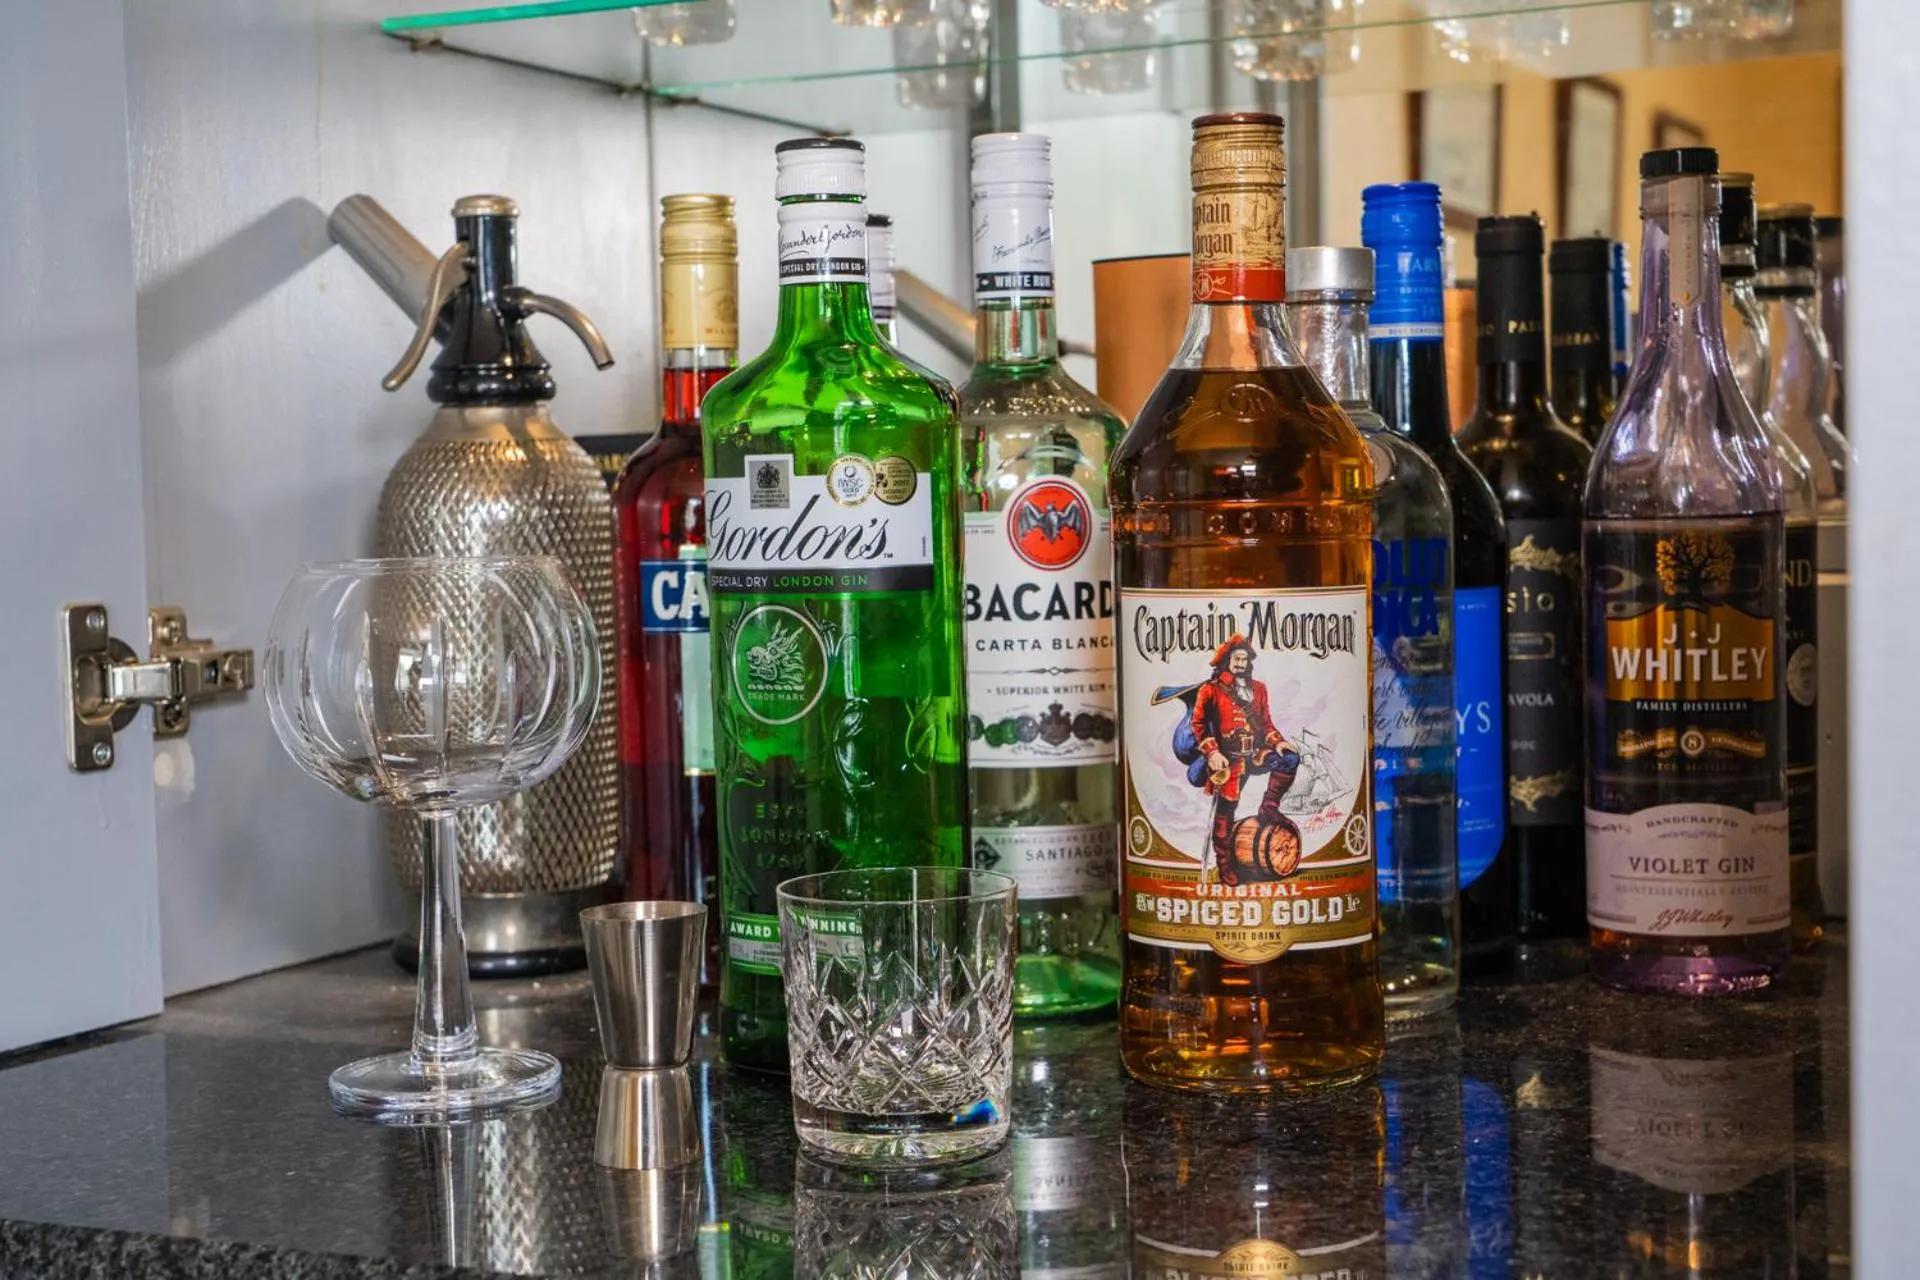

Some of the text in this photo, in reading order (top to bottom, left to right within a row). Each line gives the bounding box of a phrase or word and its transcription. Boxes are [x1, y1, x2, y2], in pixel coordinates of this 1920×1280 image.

[993, 275, 1032, 288] WHITE
[837, 478, 863, 490] IWSC
[706, 490, 890, 562] Gordon's
[711, 575, 869, 588] SPECIAL DRY LONDON GIN
[1133, 600, 1356, 664] Captain Morgan
[975, 635, 1114, 652] CARTA BLANC
[1611, 647, 1767, 682] WHITLEY
[778, 691, 805, 701] MARK
[995, 683, 1106, 696] SUPERIOR WHITE RUM
[1636, 701, 1677, 712] FAMILY
[1645, 815, 1740, 829] HANDCRAFTED
[1025, 844, 1101, 862] SANTIAGO
[1627, 856, 1757, 875] VIOLET GIN
[1196, 883, 1301, 898] ORIGINAL
[1156, 894, 1263, 926] SPICED
[1270, 894, 1344, 926] GOLD
[730, 921, 772, 938] AWARD
[1215, 930, 1281, 941] SPIRIT DRINK
